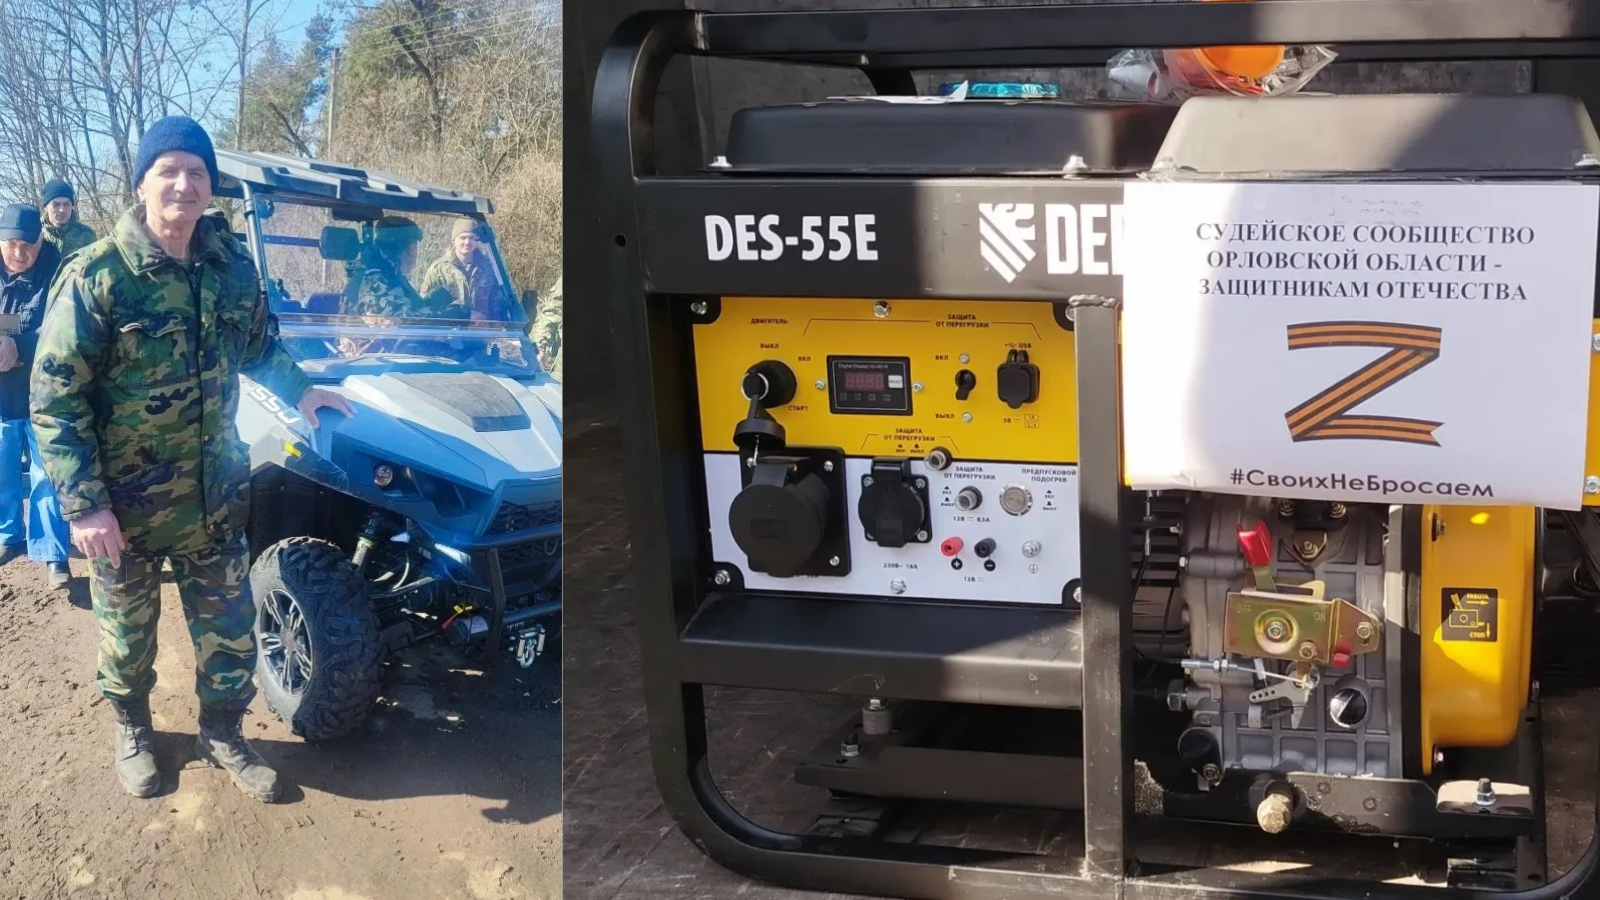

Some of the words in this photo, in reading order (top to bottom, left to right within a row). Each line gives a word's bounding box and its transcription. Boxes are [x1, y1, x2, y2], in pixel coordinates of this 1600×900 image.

[704, 213, 879, 262] DES-55E
[1196, 220, 1345, 244] СУДЕЙСКОЕ
[1353, 224, 1535, 246] СООБЩЕСТВО
[1206, 249, 1358, 271] ОРЛОВСКОЙ
[1366, 252, 1487, 273] ОБЛАСТИ
[1199, 278, 1369, 300] ЗАЩИТНИКАМ
[1376, 281, 1528, 301] ОТЕЧЕСТВА
[947, 313, 976, 321] ЗАЩИТА
[1021, 468, 1077, 476] ПРЕДПУСКОВОЙ
[1229, 467, 1494, 498] #СвоихНеБросаем
[1314, 611, 1326, 622] ON
